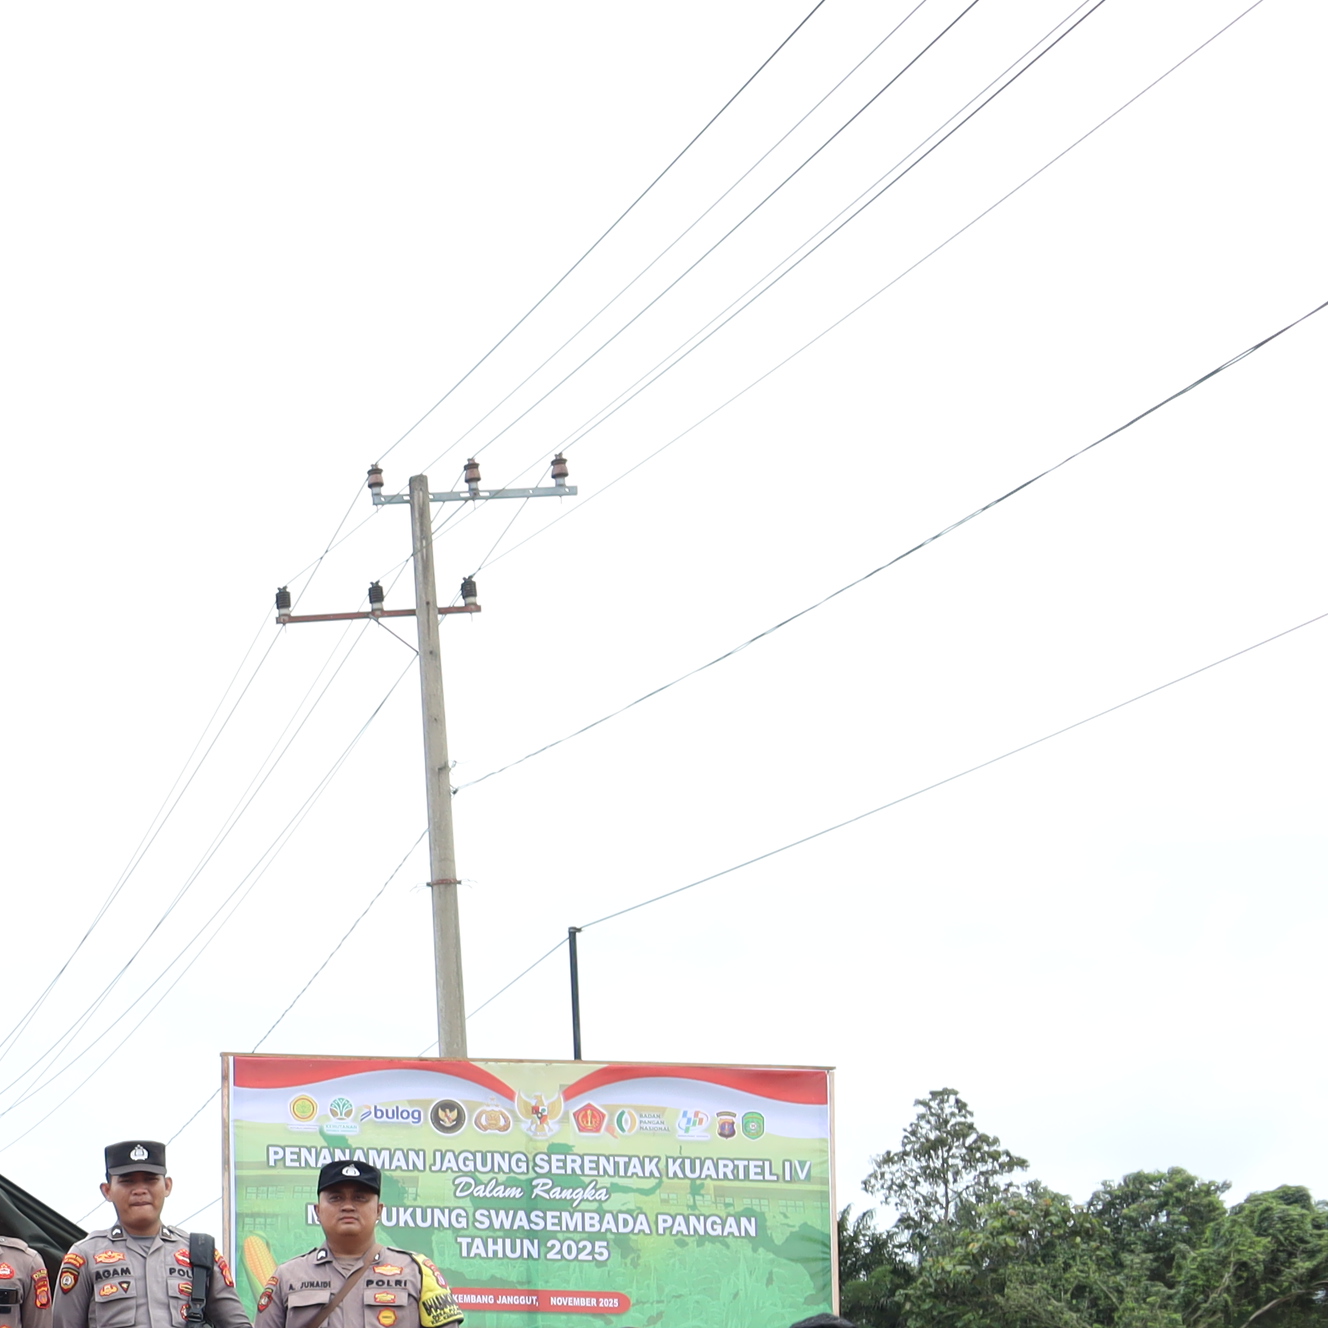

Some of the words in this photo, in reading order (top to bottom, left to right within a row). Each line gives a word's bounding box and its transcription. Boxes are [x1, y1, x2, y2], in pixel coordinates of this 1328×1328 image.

[374, 1105, 422, 1124] bulog
[268, 1146, 424, 1171] PENANAMAN
[431, 1150, 527, 1174] JAGUNG
[534, 1154, 661, 1179] SERENTAK
[667, 1158, 778, 1181] KUARTEL
[784, 1160, 812, 1182] IV
[454, 1177, 524, 1199] Dalam
[531, 1178, 610, 1207] Rangka
[307, 1204, 468, 1229] MUKUNG
[474, 1209, 651, 1235] SWASEMBADA
[657, 1214, 757, 1238] PANGAN
[456, 1237, 539, 1260] TAHUN
[546, 1239, 609, 1261] 2025
[95, 1267, 131, 1281] AGAM
[169, 1267, 193, 1279] POL
[300, 1280, 331, 1290] JUNAIDI
[366, 1279, 407, 1288] POLRI
[453, 1294, 494, 1304] KEMBANG
[496, 1295, 539, 1307] JANGGUT,
[550, 1296, 597, 1307] NOVEMBER
[599, 1298, 619, 1308] 2025
